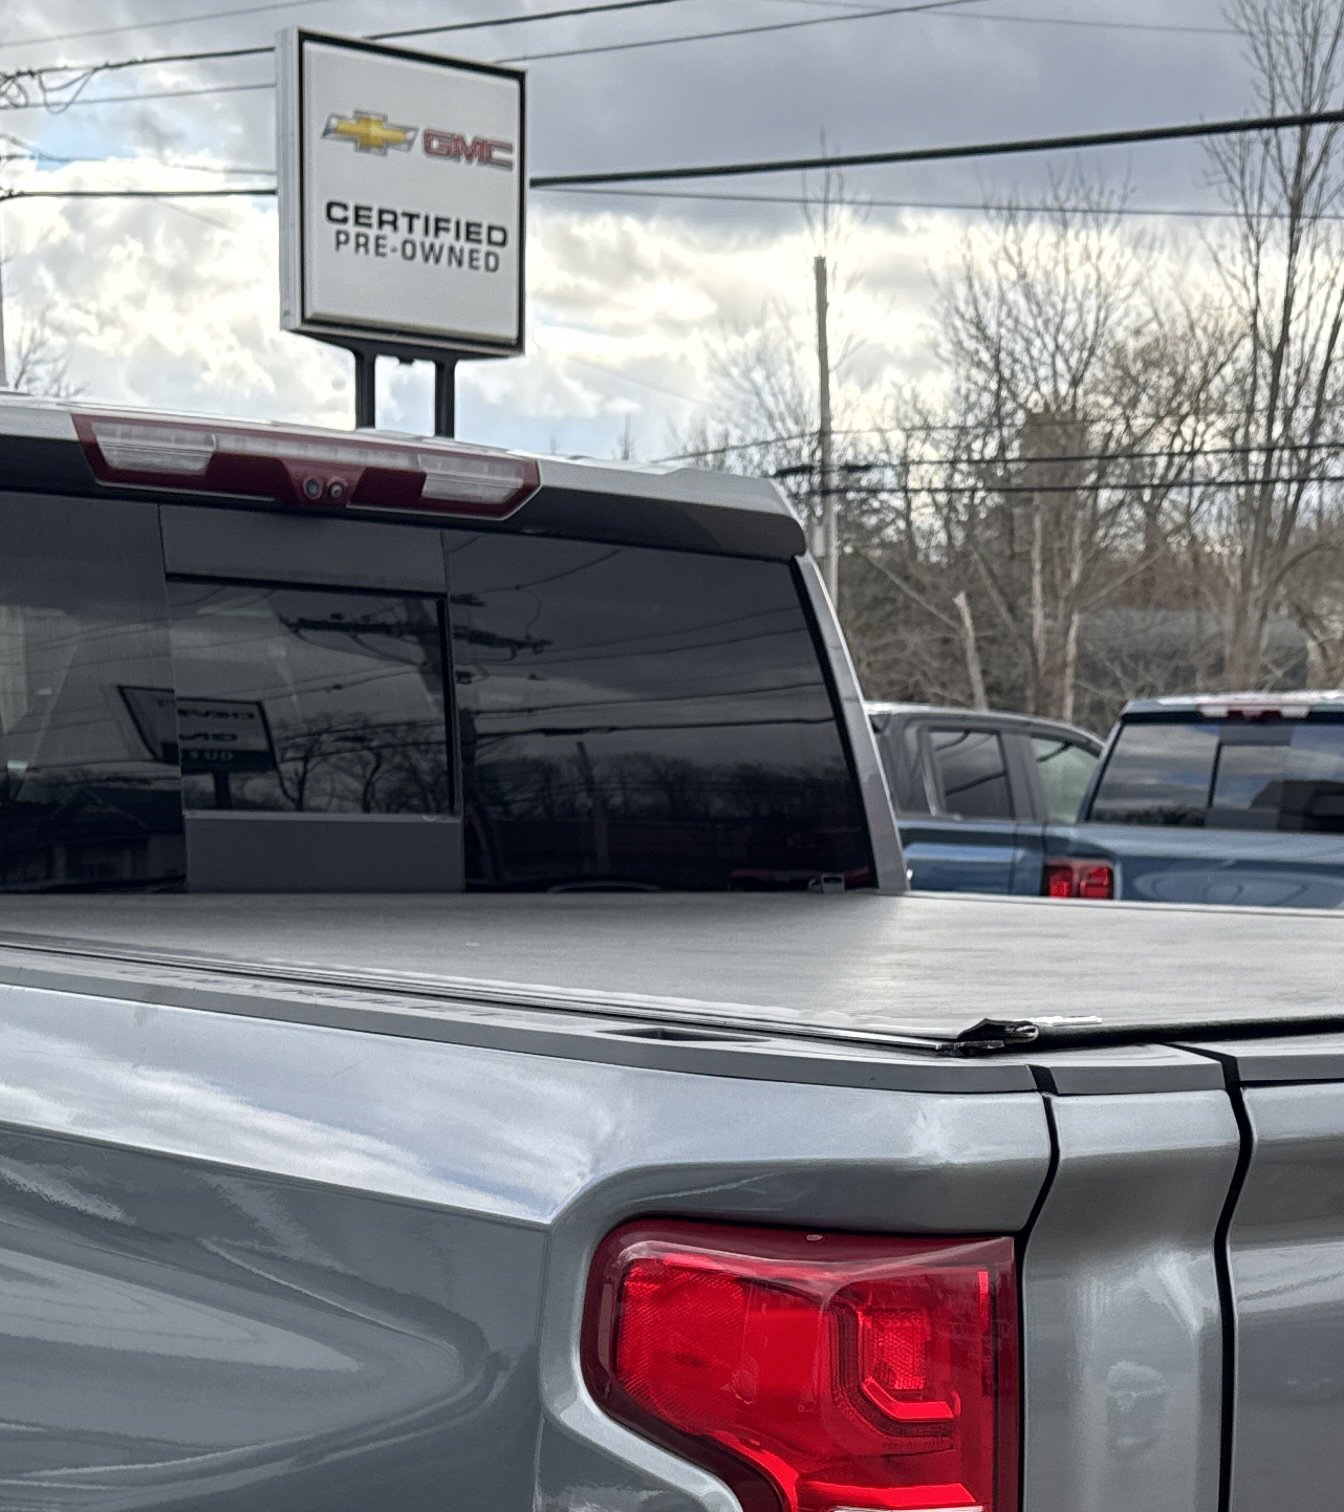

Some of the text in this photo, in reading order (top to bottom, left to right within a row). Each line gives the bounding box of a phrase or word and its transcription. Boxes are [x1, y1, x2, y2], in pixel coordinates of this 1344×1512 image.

[423, 128, 513, 171] GMC
[326, 201, 507, 247] CERTIFIED
[335, 229, 499, 273] PRE-OWNED
